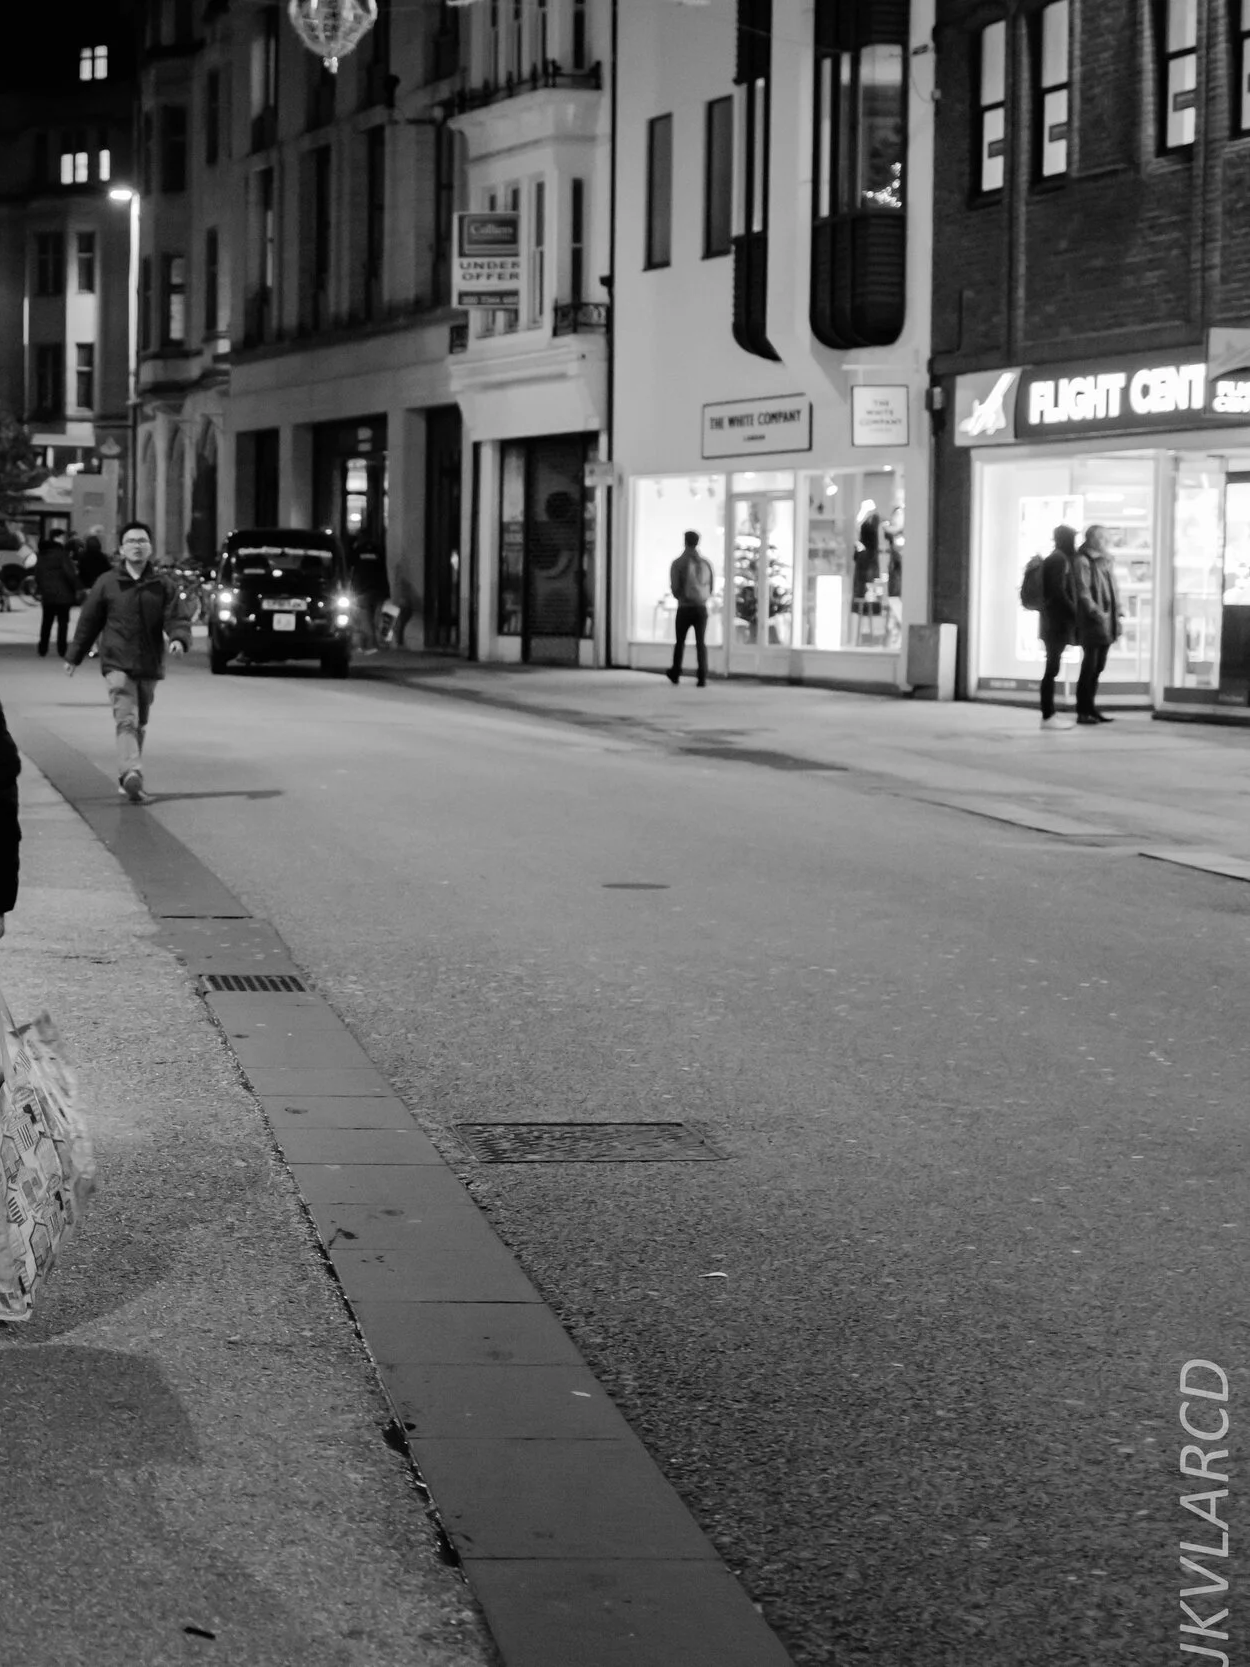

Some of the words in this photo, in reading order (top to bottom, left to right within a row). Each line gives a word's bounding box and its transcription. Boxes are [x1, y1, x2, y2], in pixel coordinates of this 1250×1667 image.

[459, 260, 520, 270] UNDER
[461, 271, 520, 281] OFFER
[1029, 372, 1126, 425] FLIGHT
[1130, 363, 1207, 416] CENT
[709, 416, 724, 430] THE
[727, 413, 754, 429] WHITE
[757, 408, 802, 426] COMPANY
